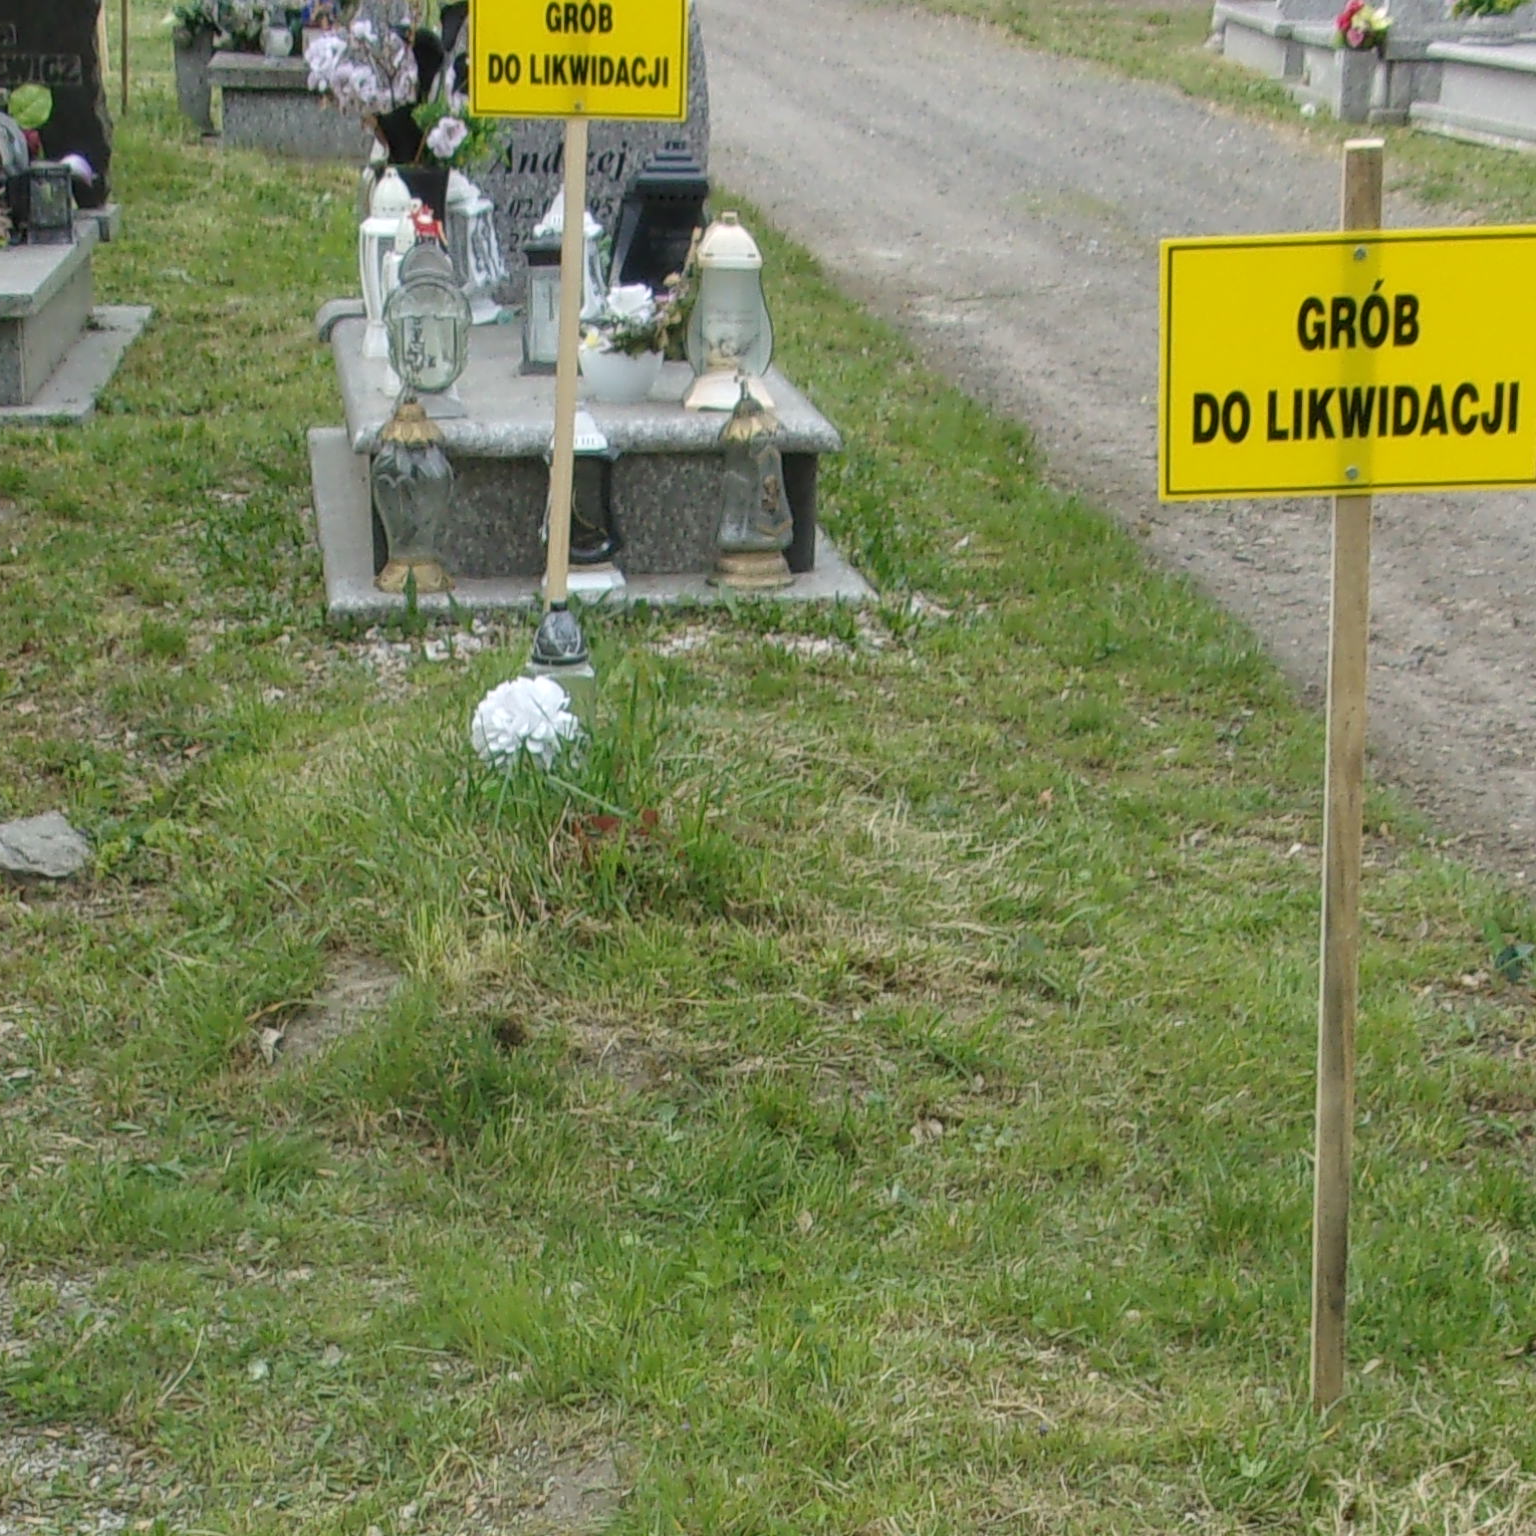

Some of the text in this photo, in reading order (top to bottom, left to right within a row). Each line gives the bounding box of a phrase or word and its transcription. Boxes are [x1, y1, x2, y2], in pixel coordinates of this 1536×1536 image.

[544, 0, 614, 34] GRÓB
[488, 53, 670, 88] DO LIKWIDACJI
[1296, 278, 1421, 352] GRÓB
[1192, 381, 1520, 445] DO LIKWIDACJI
